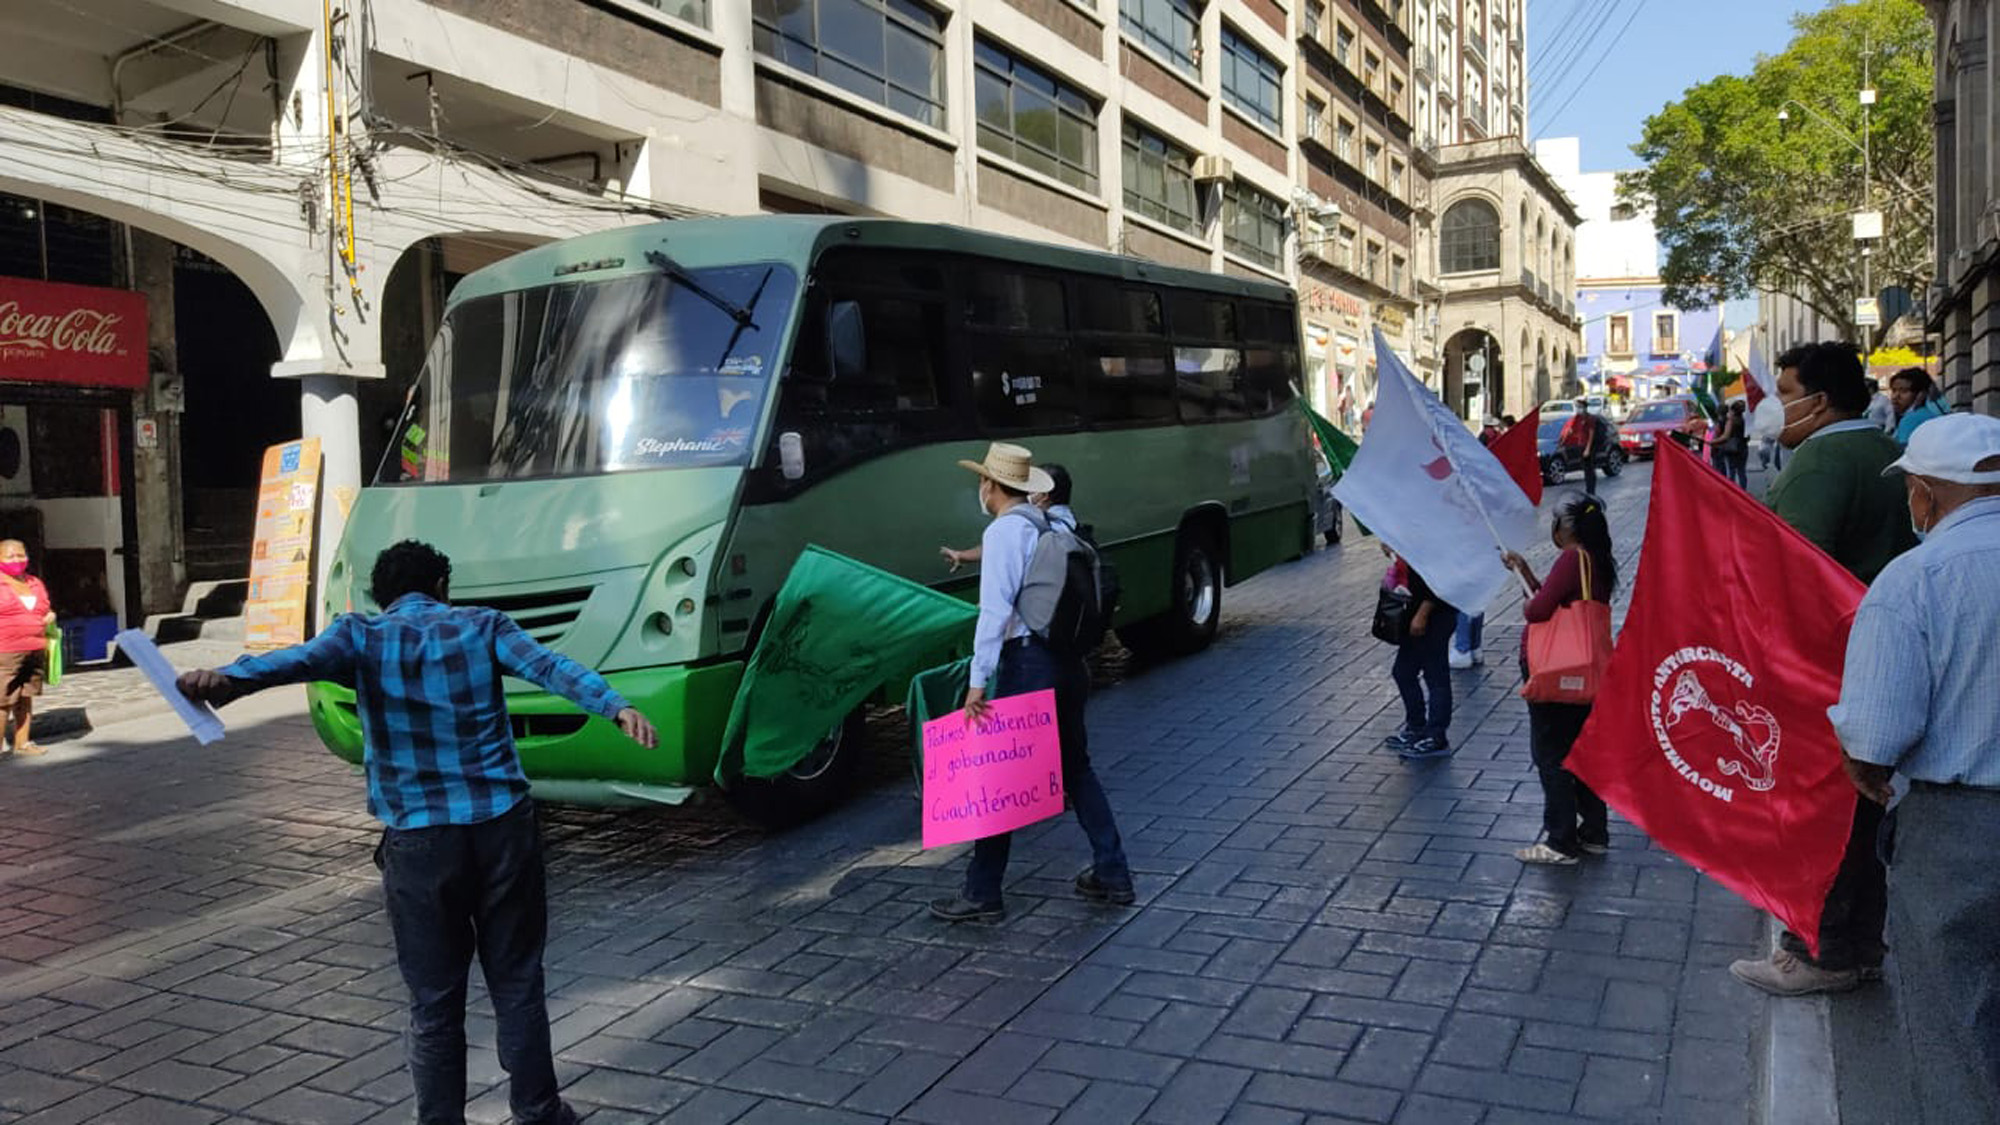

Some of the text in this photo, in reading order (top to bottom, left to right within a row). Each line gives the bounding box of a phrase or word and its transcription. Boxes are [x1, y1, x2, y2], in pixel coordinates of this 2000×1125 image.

[634, 437, 725, 457] Stephanie
[976, 711, 1051, 735] audiencia
[1651, 646, 1754, 803] MOVIMIENTO ANTRCHSTA
[932, 785, 1041, 821] Cuauhtémoc
